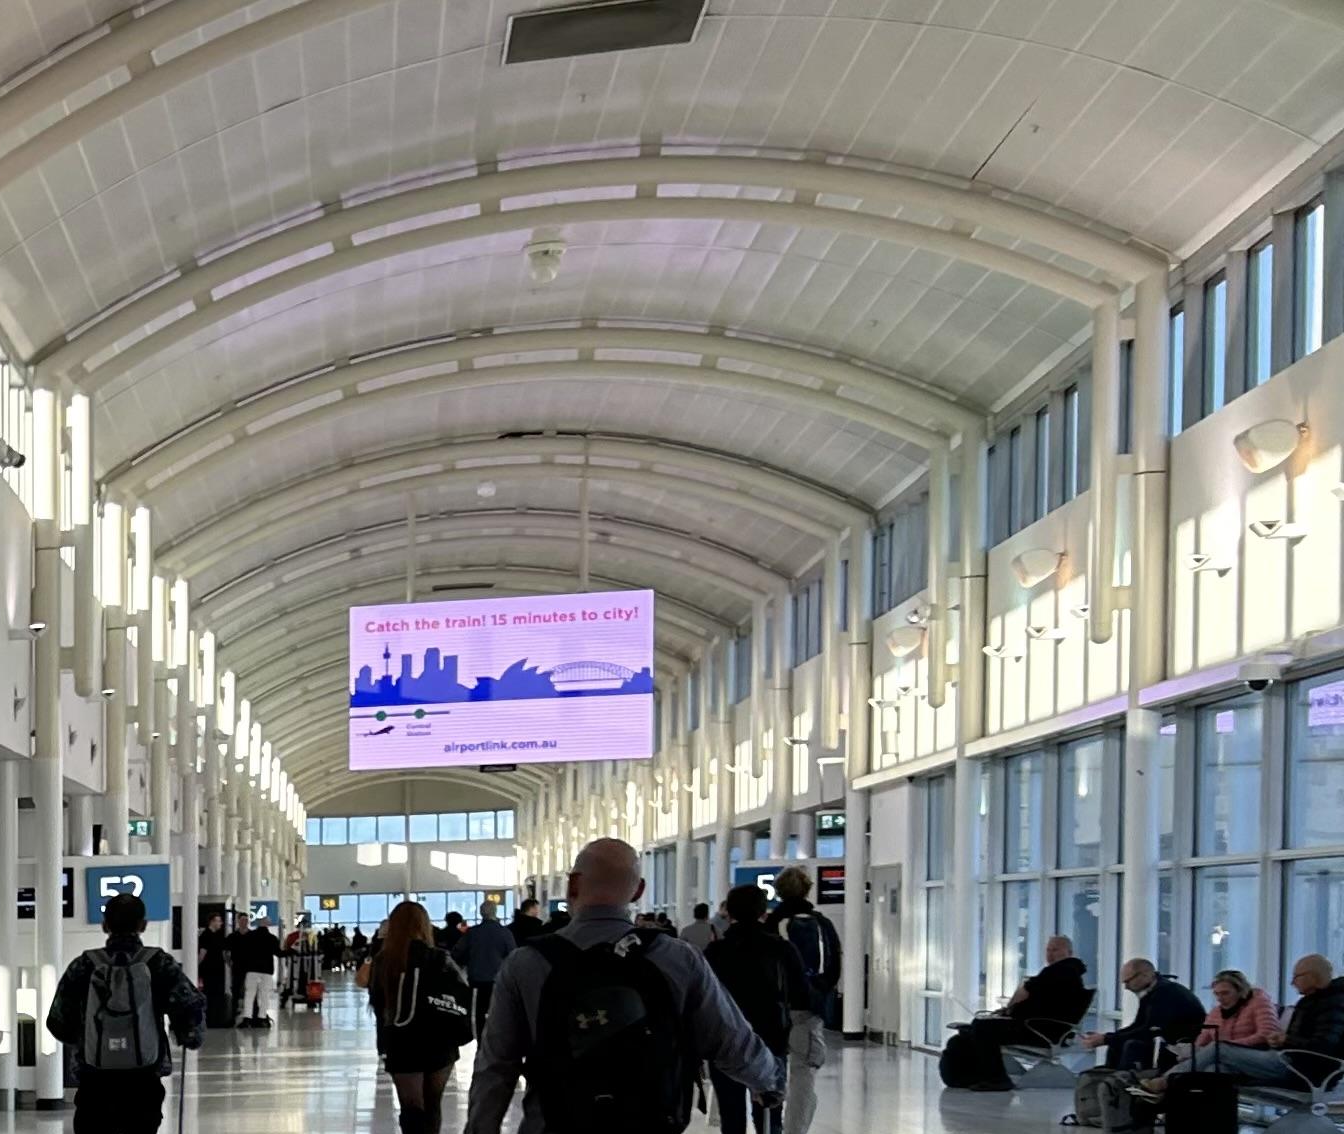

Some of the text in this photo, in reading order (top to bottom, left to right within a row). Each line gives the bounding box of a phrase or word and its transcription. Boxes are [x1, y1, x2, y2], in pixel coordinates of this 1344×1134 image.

[365, 606, 639, 634] Catch the train! 15 minutes to city!
[444, 738, 557, 754] airportlink.com.au
